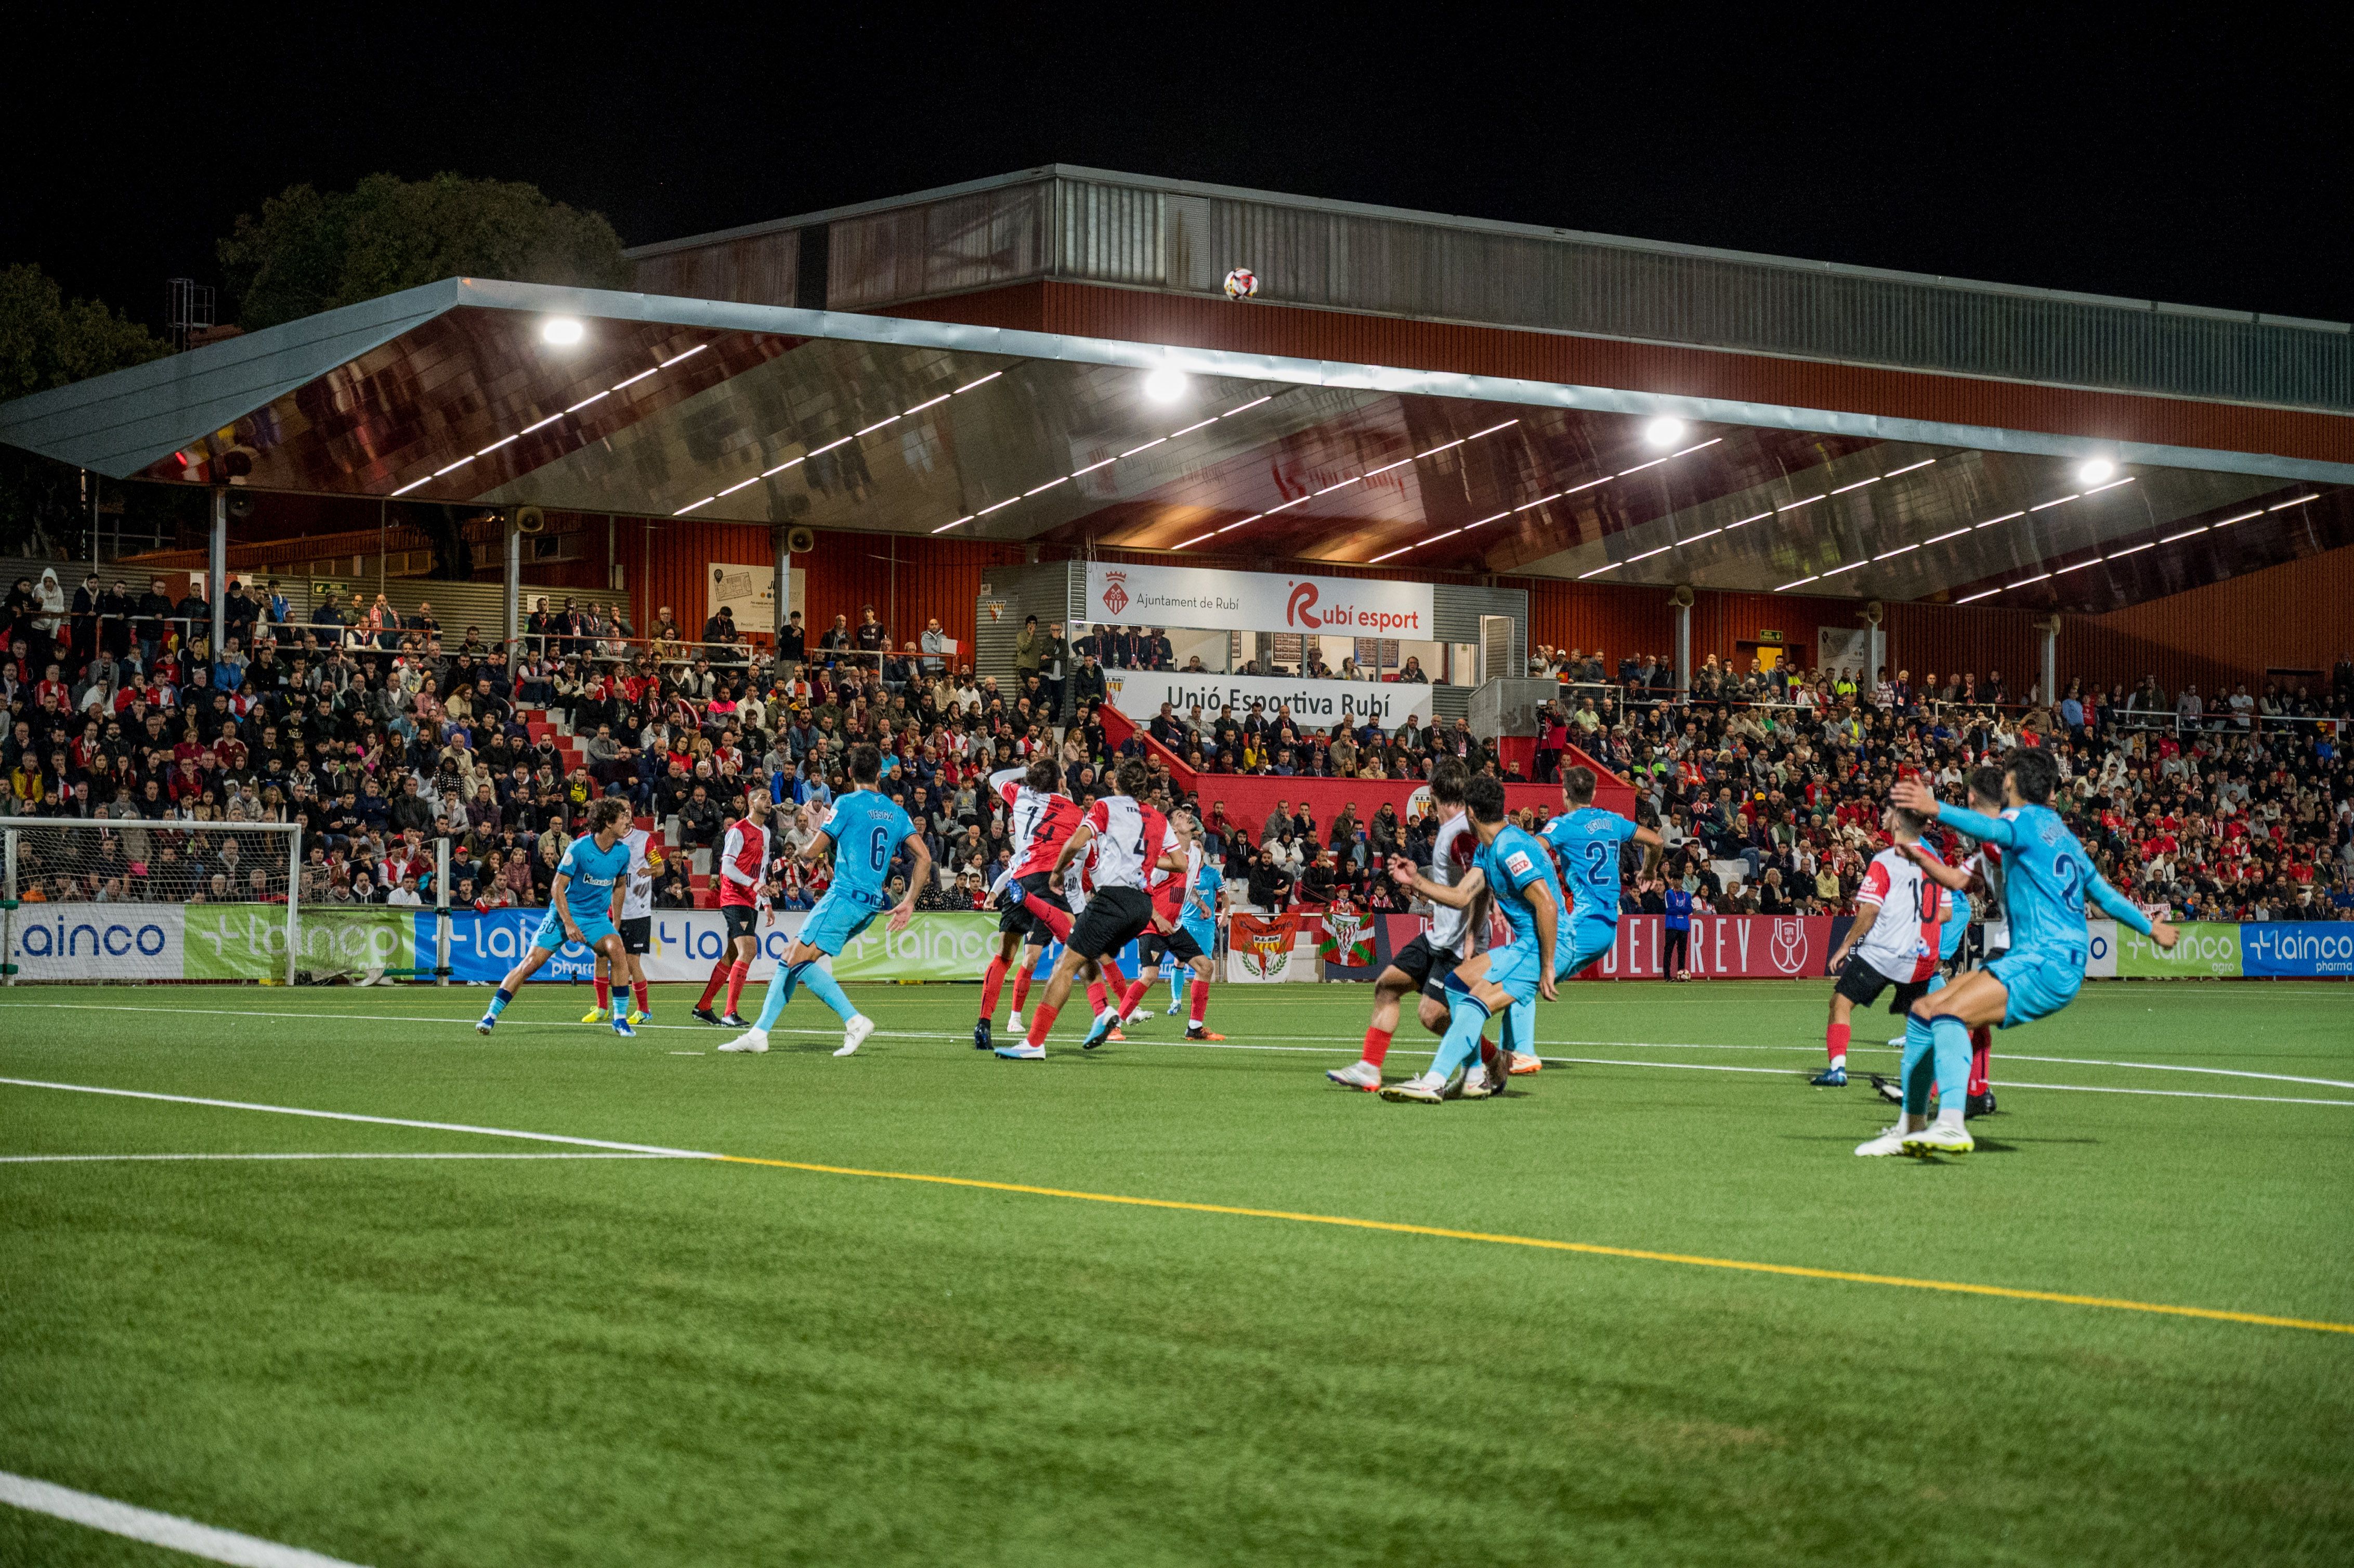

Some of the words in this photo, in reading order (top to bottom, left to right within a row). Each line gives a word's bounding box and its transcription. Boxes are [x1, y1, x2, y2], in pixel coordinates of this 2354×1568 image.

[1137, 593, 1197, 608] Ajuntament
[1200, 596, 1213, 608] de
[1216, 598, 1239, 610] Rubí
[1287, 581, 1354, 629] Rubí
[1358, 611, 1418, 632] esport
[1168, 686, 1221, 710] Unió
[1230, 689, 1332, 712] Esportiva
[1341, 693, 1391, 717] Rubí
[867, 809, 893, 823] VESGA
[1023, 806, 1058, 844] 14
[869, 826, 888, 873] 6
[1133, 822, 1149, 859] 4
[2054, 851, 2084, 913] 2
[1908, 878, 1937, 924] 10
[15, 914, 165, 957] ainco
[1690, 918, 1751, 974] REY
[2274, 930, 2353, 960] lainco
[552, 960, 598, 978] phar
[2212, 963, 2234, 974] agro
[2316, 960, 2352, 974] pharma
